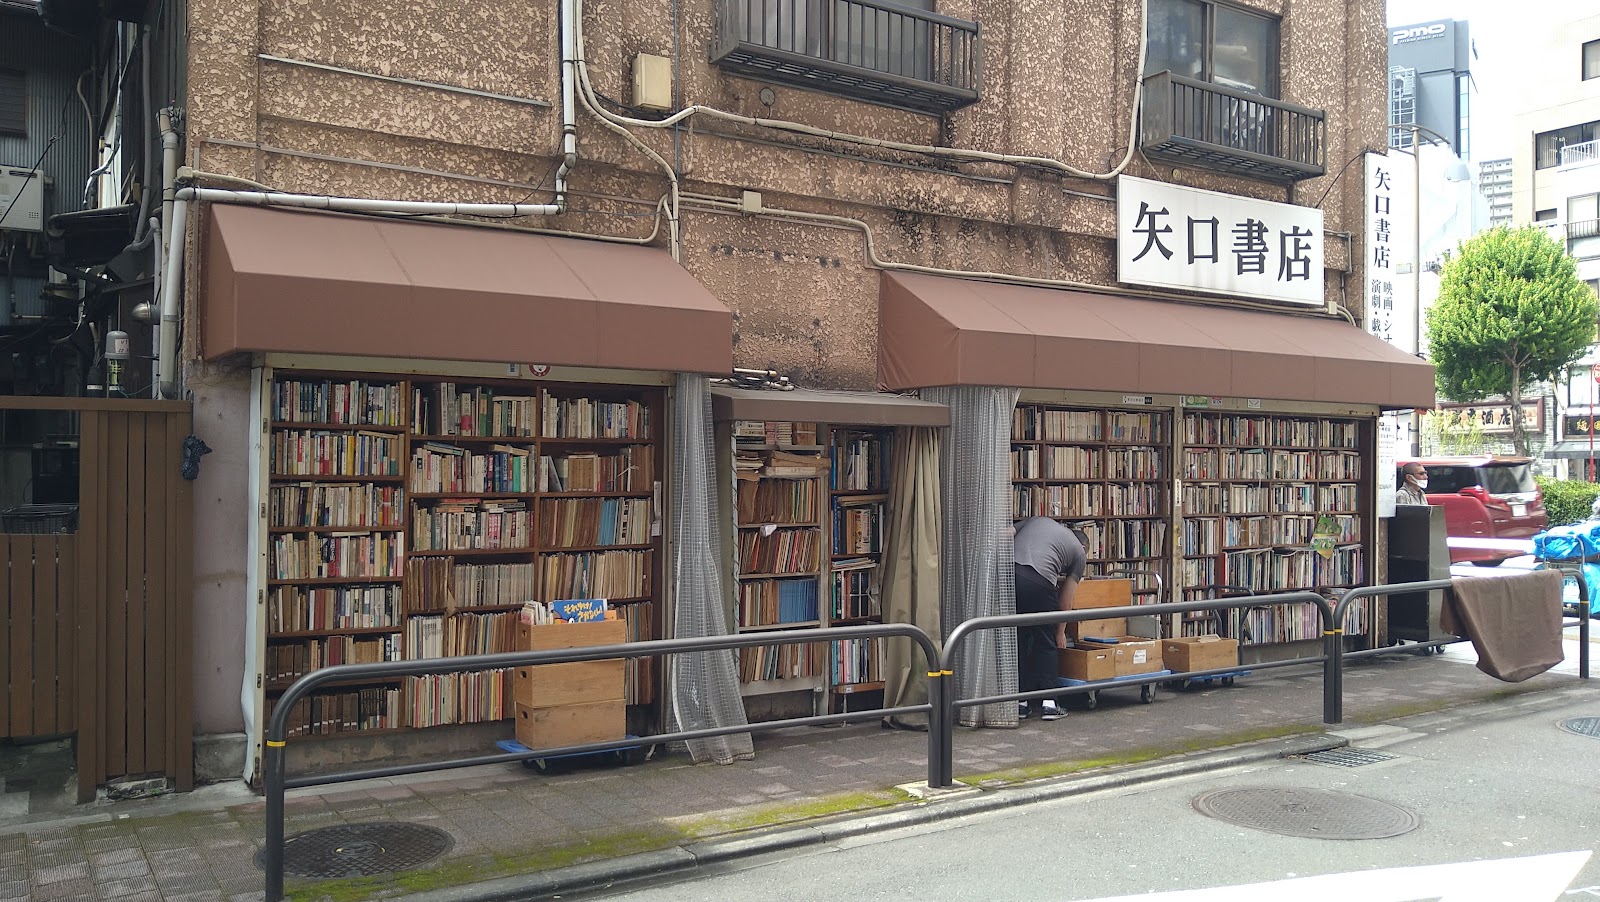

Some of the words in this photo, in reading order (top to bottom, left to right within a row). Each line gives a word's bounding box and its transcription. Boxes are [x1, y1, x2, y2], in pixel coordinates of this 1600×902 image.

[1132, 201, 1313, 282] 矢口書店
[1374, 167, 1391, 269] 矢口書店
